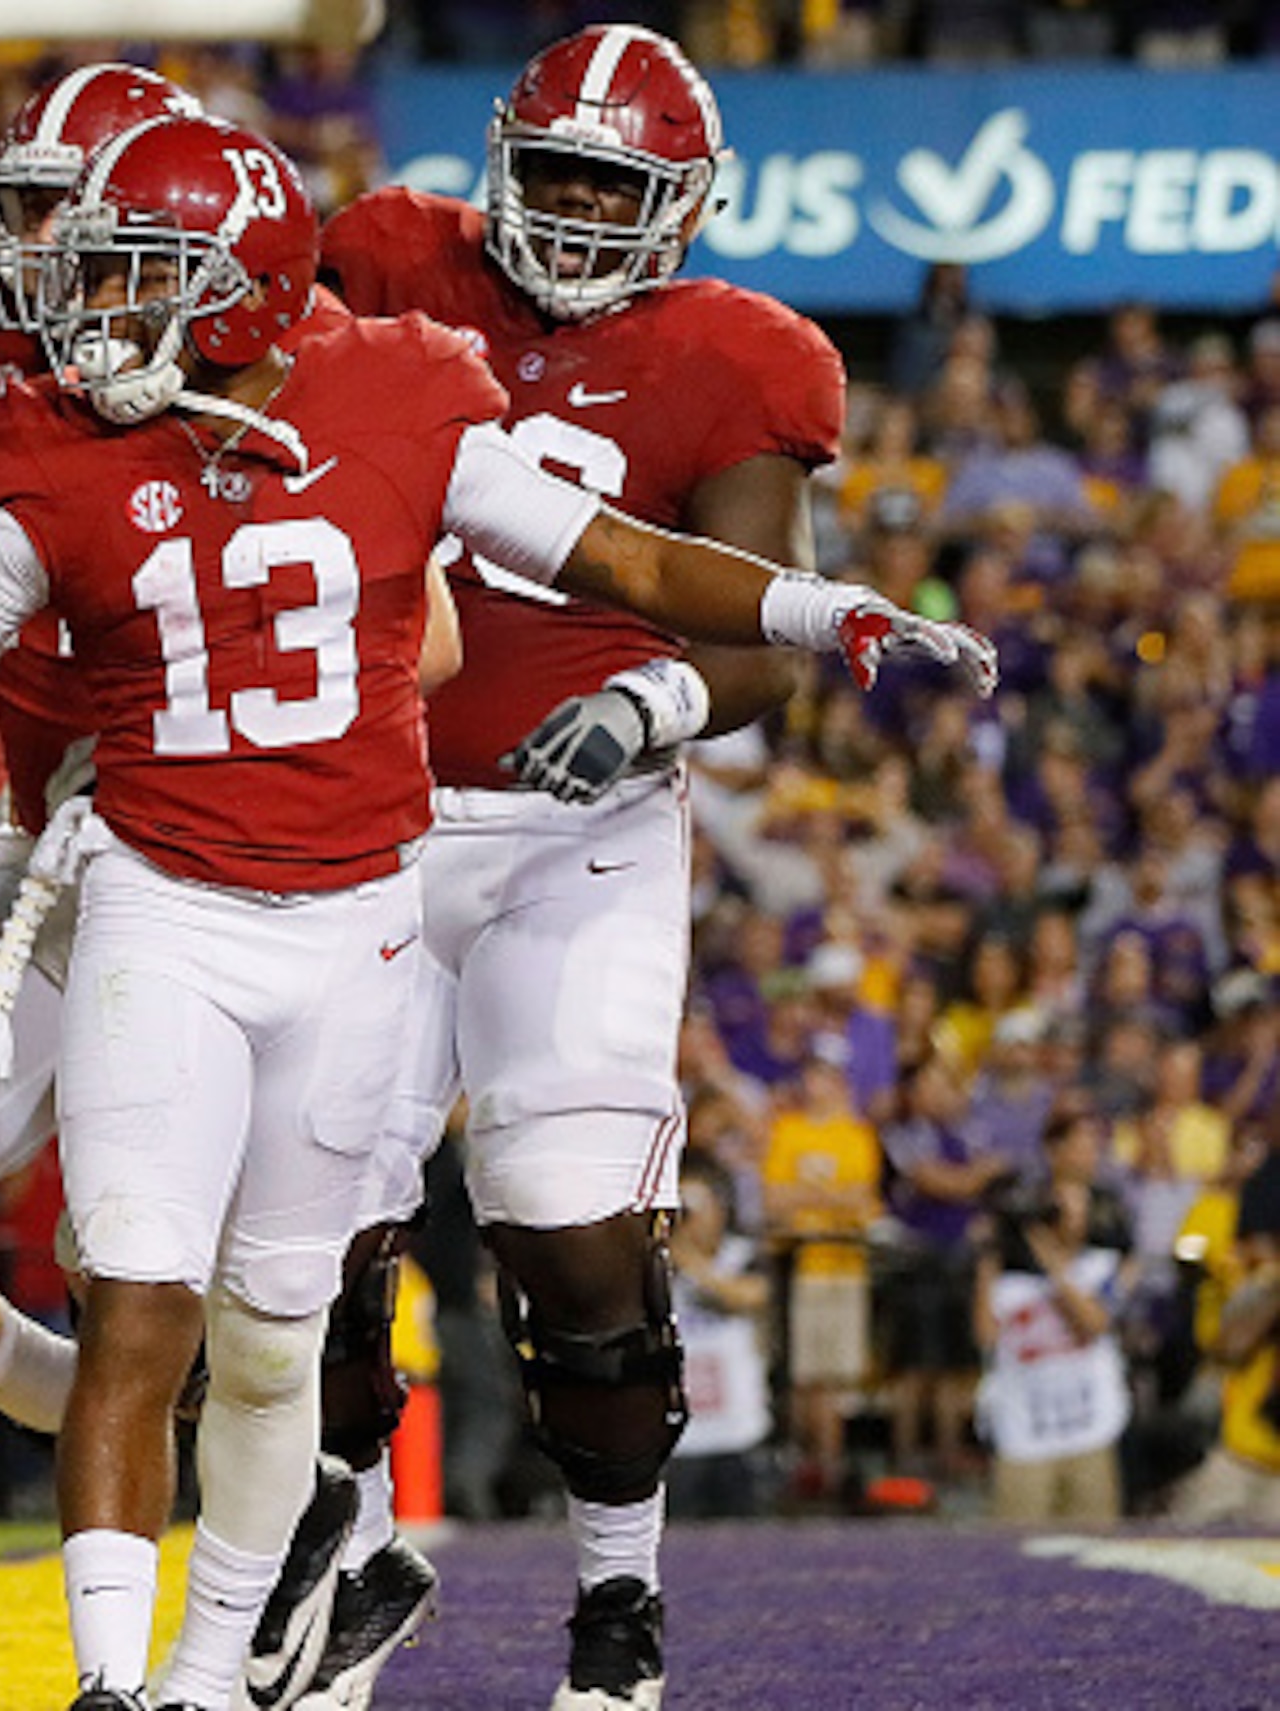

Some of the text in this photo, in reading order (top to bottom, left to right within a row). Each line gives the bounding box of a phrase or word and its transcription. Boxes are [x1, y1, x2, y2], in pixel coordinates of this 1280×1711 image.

[222, 148, 287, 218] 13
[1060, 149, 1280, 256] FED
[128, 480, 184, 533] SEC
[131, 515, 361, 756] 13
